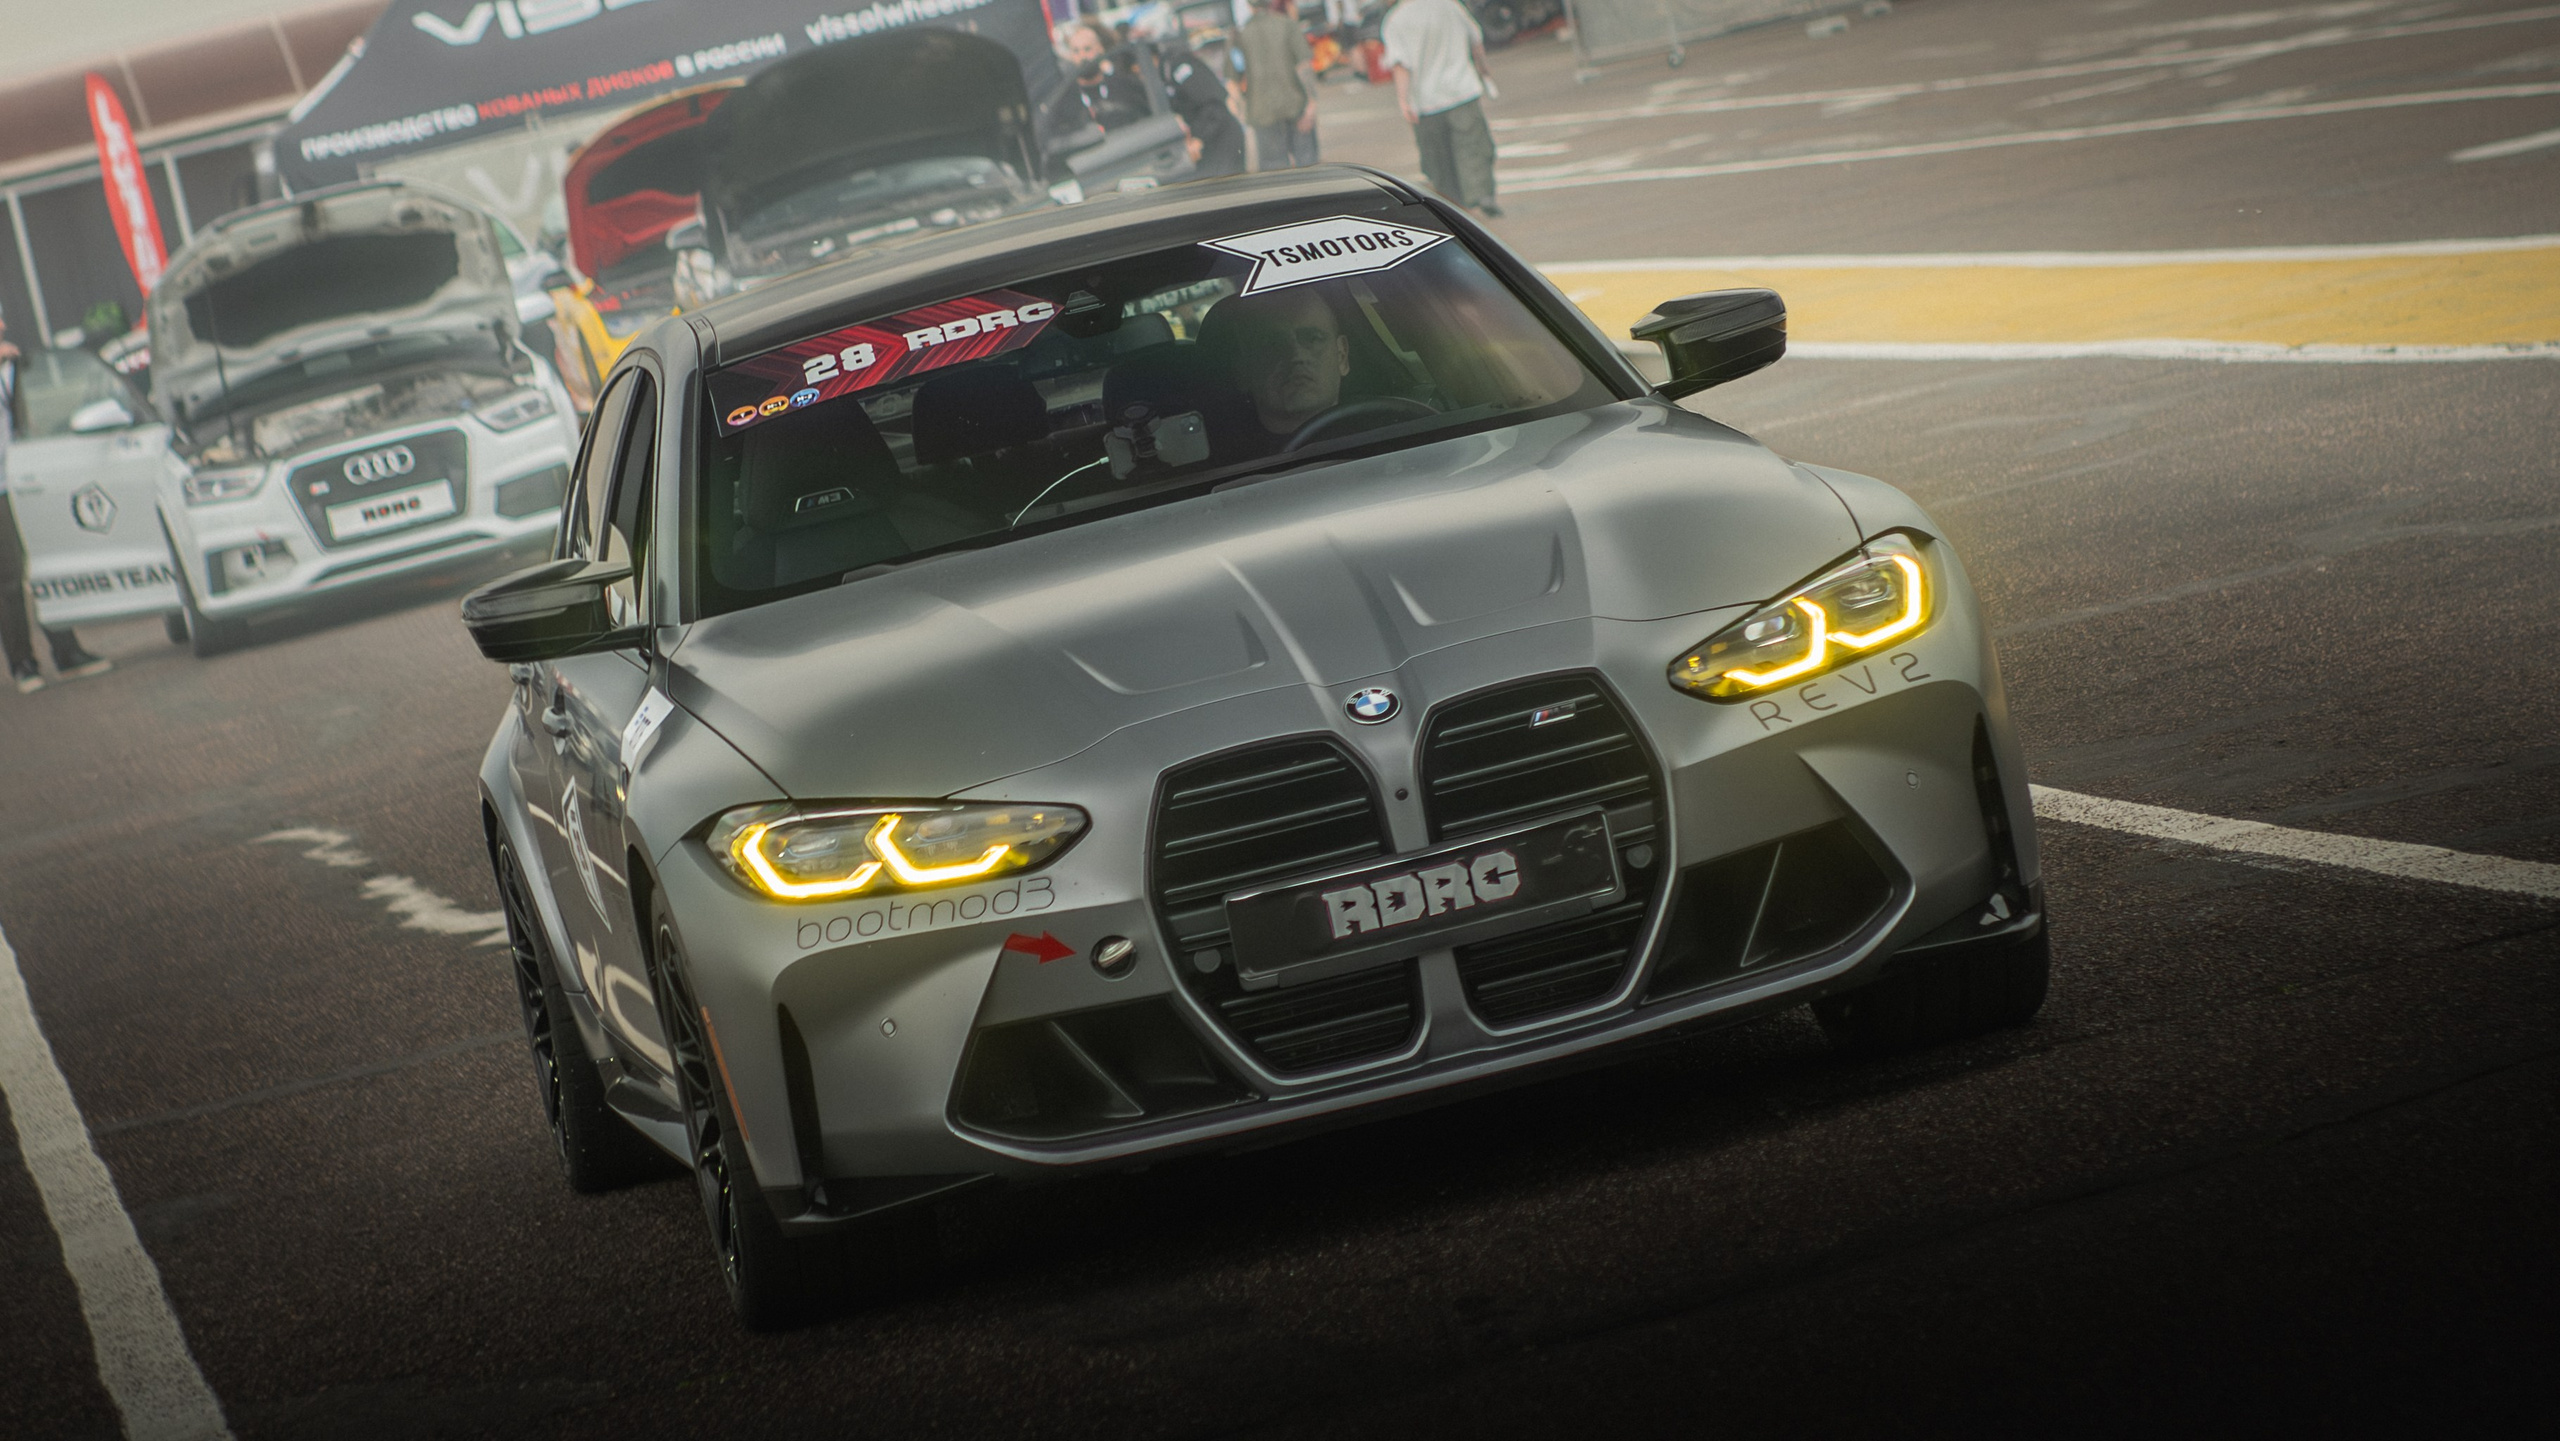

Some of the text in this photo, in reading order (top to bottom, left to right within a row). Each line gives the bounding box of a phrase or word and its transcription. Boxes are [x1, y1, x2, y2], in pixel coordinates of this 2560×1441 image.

[301, 32, 787, 162] ПРОИЗВОДСТВО КОВАНЫХ ДИСКОВ В РОССИИ
[1261, 229, 1414, 267] TSMOTORS
[803, 301, 1055, 385] 28 RDRC
[797, 875, 1056, 950] bootmod3
[1321, 850, 1522, 940] RDRC
